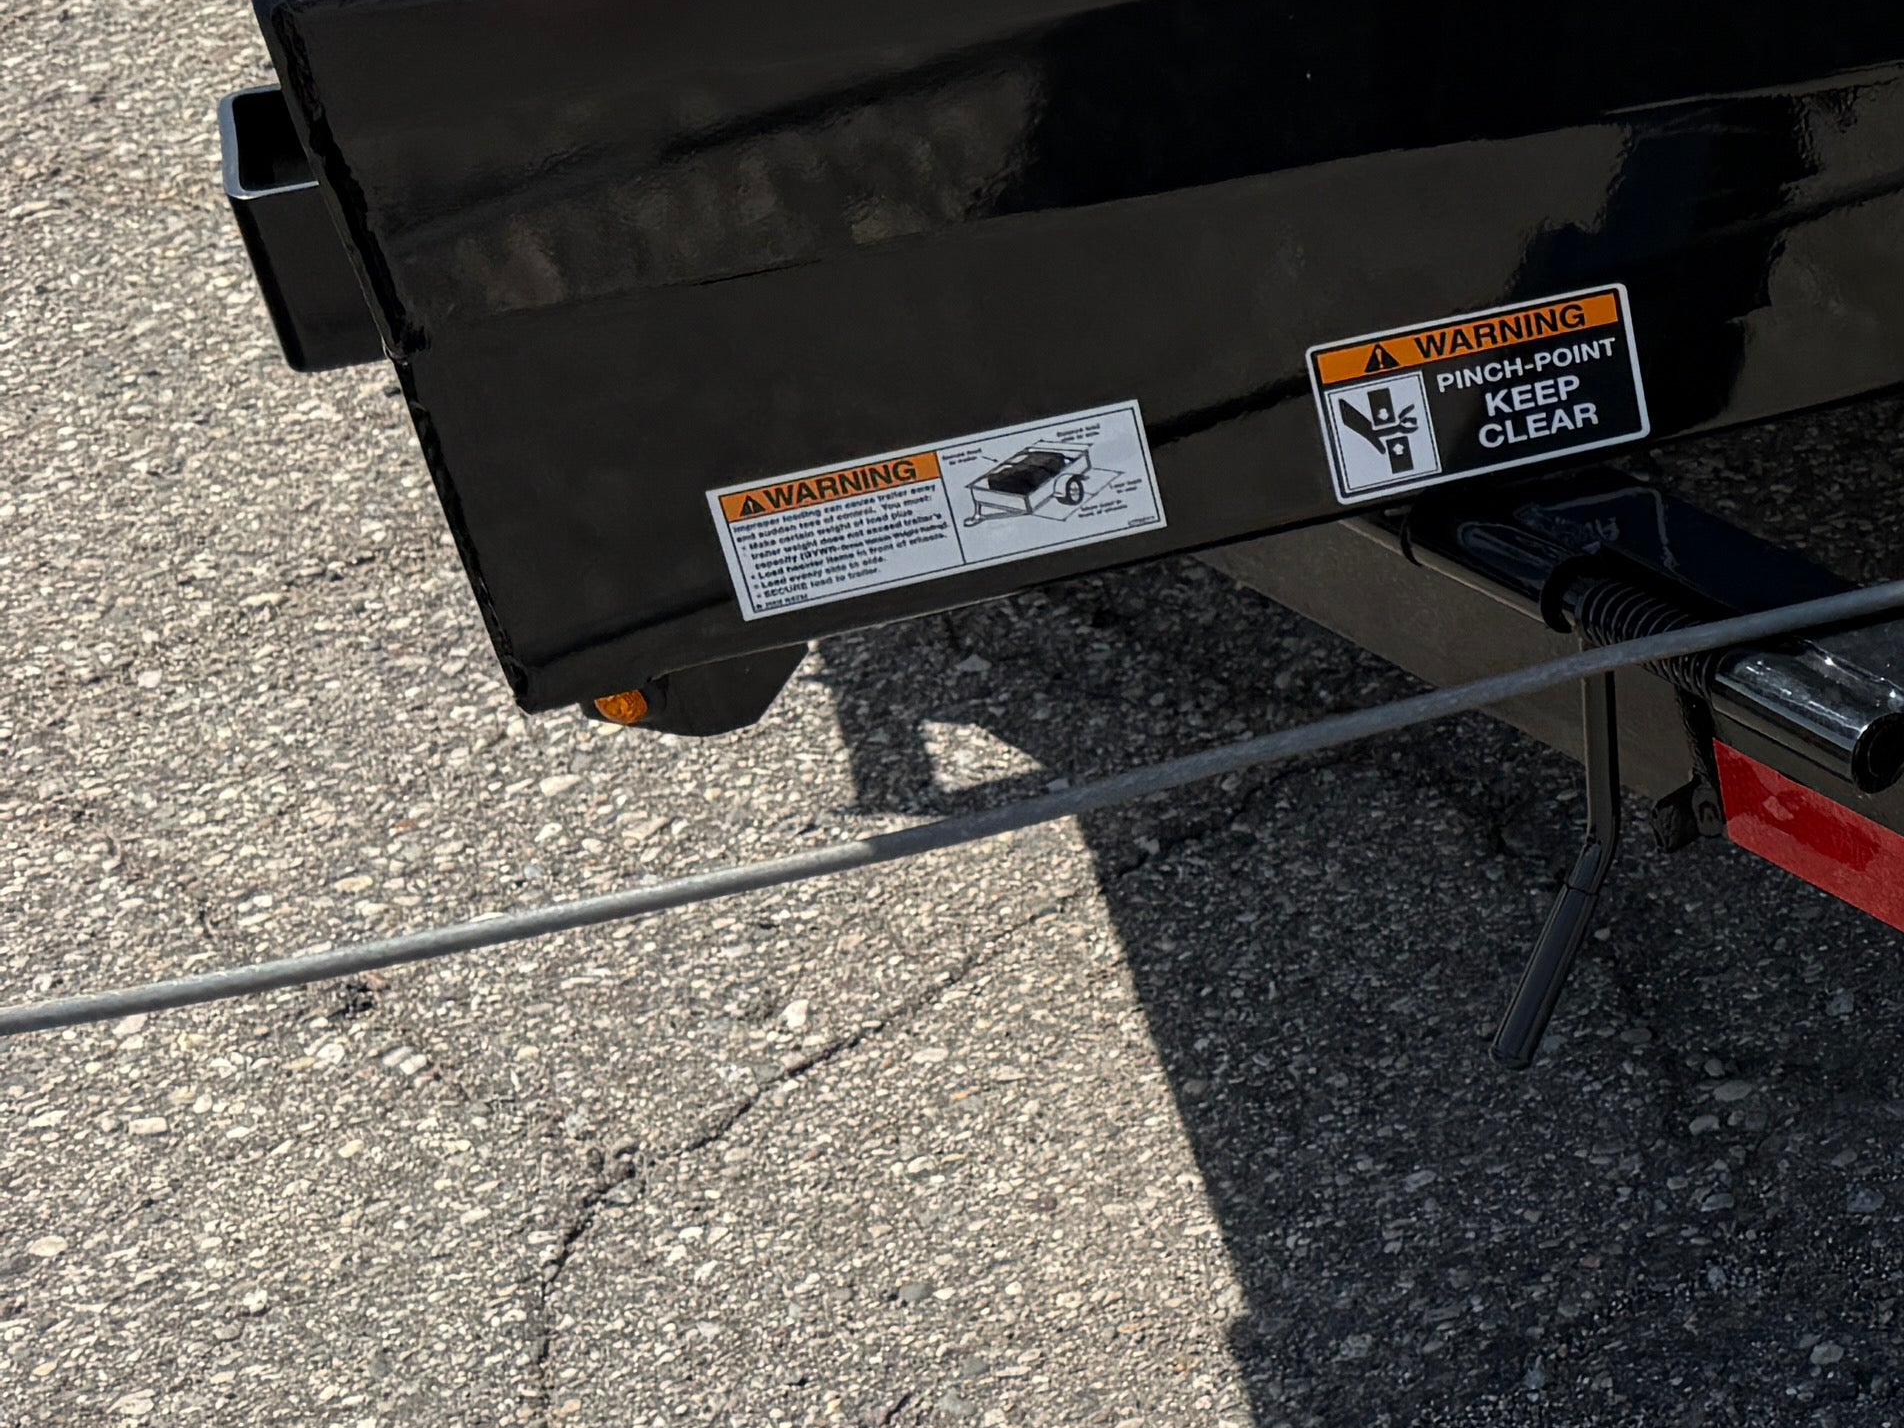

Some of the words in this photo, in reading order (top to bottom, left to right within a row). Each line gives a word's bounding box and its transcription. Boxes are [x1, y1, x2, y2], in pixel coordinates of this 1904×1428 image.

[1414, 301, 1586, 361] WARNING
[1436, 336, 1618, 393] PINCH-POINT
[1484, 373, 1582, 417] KEEP
[1476, 401, 1599, 450] CLEAR
[762, 459, 918, 510] WARNING
